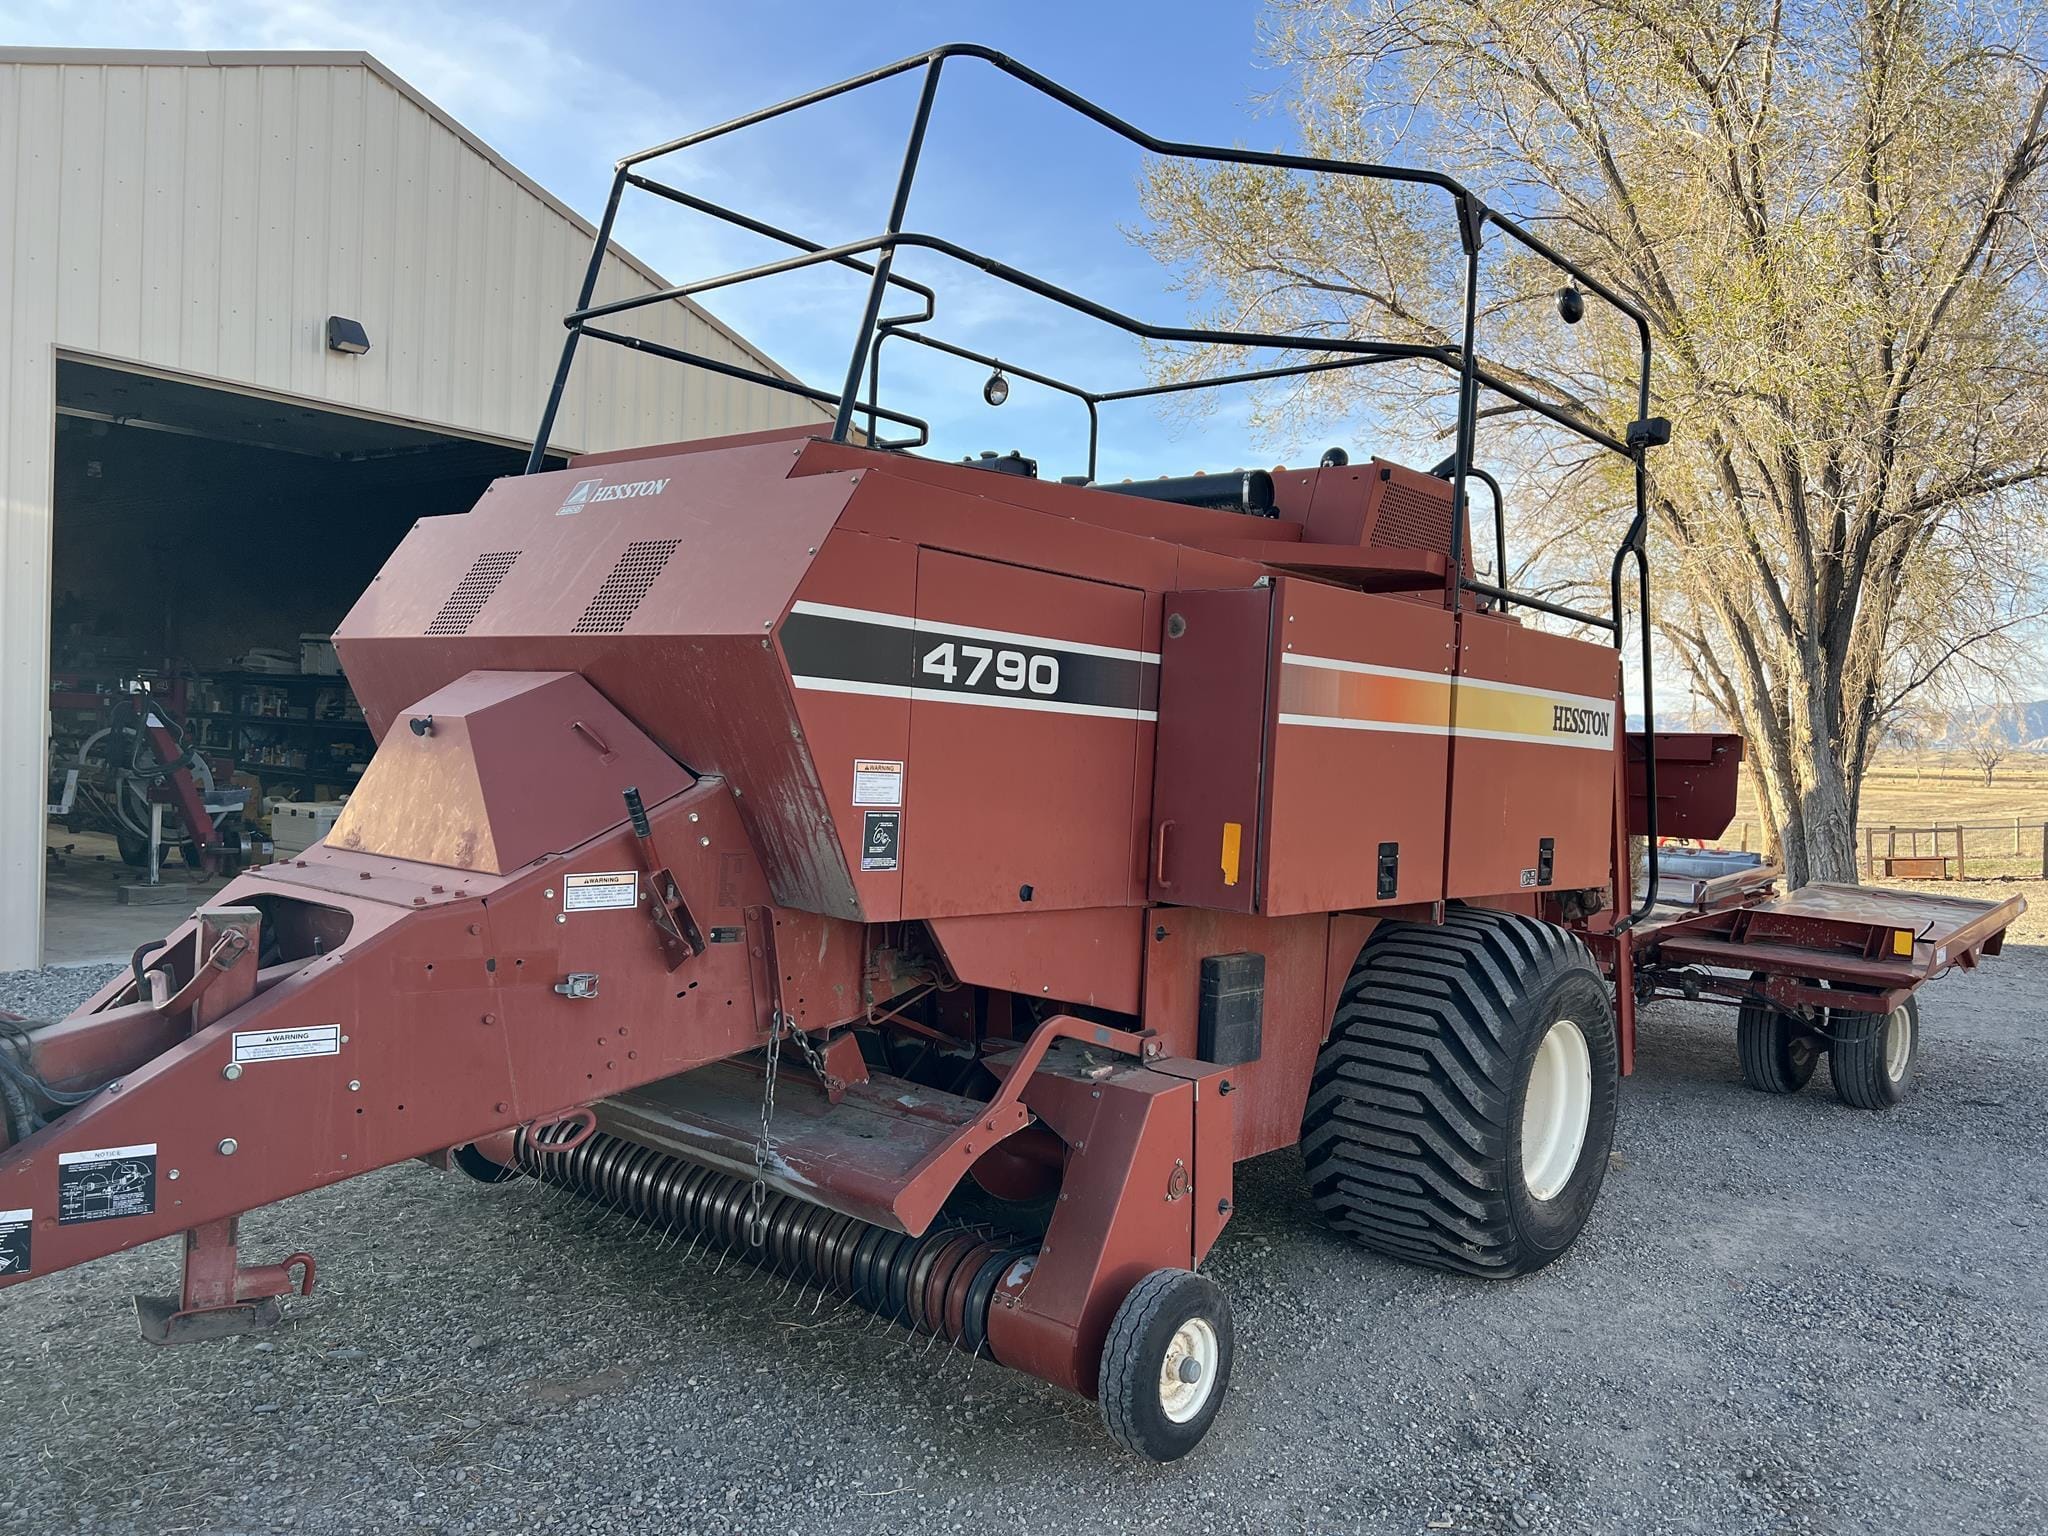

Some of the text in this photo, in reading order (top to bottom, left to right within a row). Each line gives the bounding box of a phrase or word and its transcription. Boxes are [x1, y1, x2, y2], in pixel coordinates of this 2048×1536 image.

[589, 478, 671, 503] HESSTON
[922, 642, 1059, 694] 4790
[1552, 705, 1610, 737] HESSTON
[272, 1032, 309, 1041] WARNING
[95, 1150, 121, 1158] NOTICE
